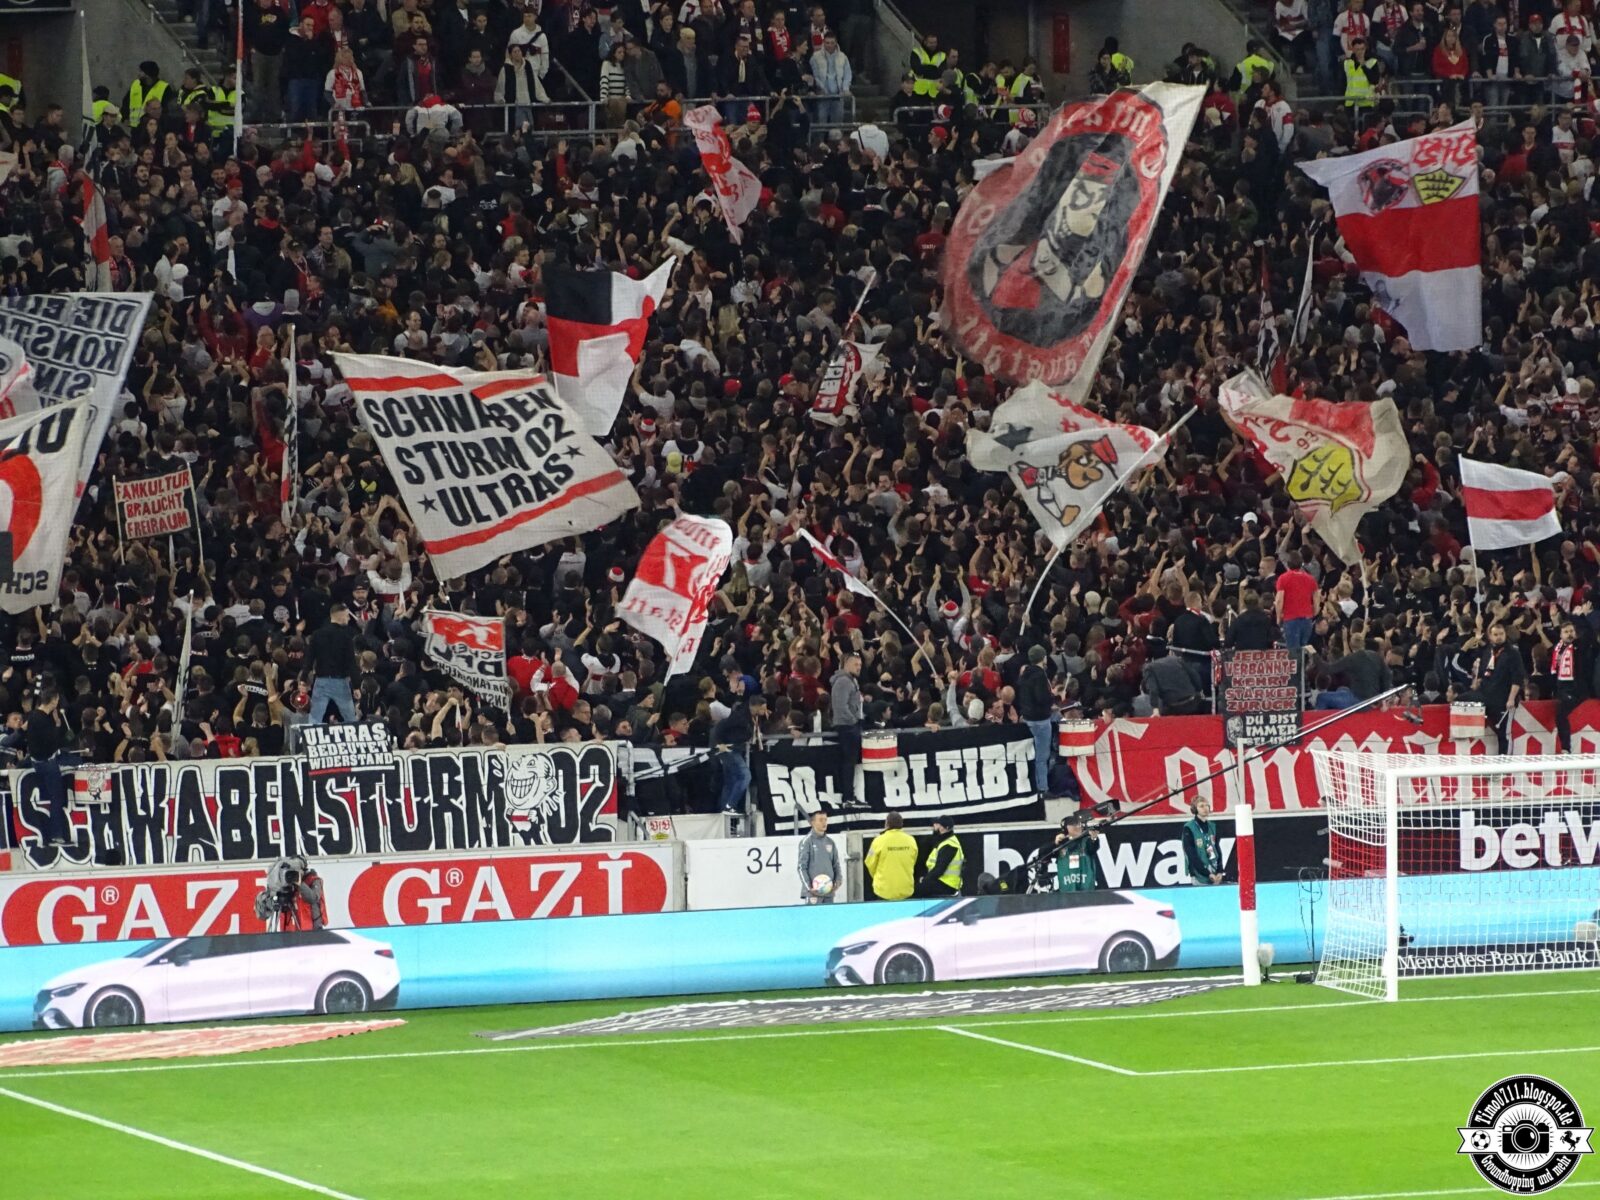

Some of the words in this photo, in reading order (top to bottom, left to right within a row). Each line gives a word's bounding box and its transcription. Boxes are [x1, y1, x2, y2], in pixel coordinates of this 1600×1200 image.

[363, 389, 562, 438] SCHWABEN
[396, 437, 531, 485] STURM
[525, 413, 575, 458] 02
[437, 453, 574, 527] ULTRAS
[126, 492, 182, 519] BRAUCHT
[127, 511, 189, 538] FREIRAUM
[1233, 650, 1288, 660] JEDER
[1225, 660, 1297, 676] VERBANNTE
[1232, 675, 1290, 687] KEHRT
[1269, 713, 1298, 724] BIST
[304, 723, 387, 745] ULTRAS
[1246, 724, 1297, 736] IMMER
[307, 740, 389, 758] BEDEUTET
[309, 752, 394, 770] WIDERSTAND
[882, 737, 1035, 808] BLEIBT
[747, 846, 782, 874] 34
[1063, 873, 1087, 885] HOST
[1399, 951, 1535, 969] Mercedes-Benz
[1541, 947, 1590, 964] Bank
